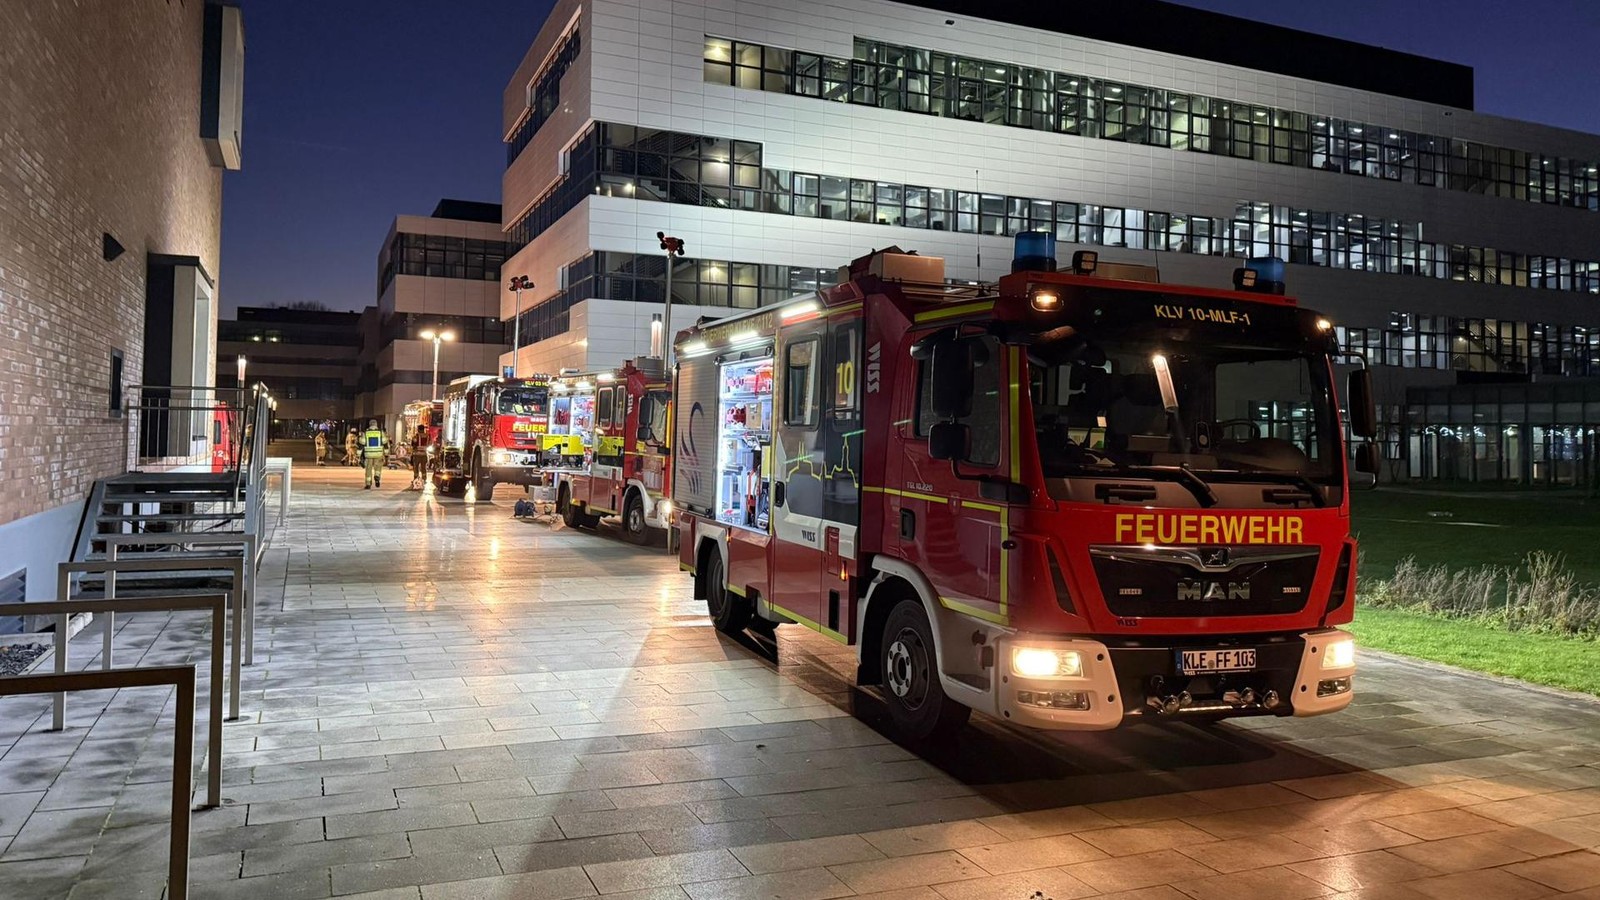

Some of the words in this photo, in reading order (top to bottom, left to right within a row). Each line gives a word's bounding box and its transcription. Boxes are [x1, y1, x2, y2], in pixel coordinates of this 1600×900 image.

[1154, 304, 1183, 319] KLV
[1187, 307, 1251, 326] 10-MLF-1
[836, 361, 855, 394] 10
[1115, 513, 1303, 544] FEUERWEHR
[1177, 582, 1251, 601] MAN
[1183, 652, 1207, 670] KLE
[1216, 651, 1231, 669] FF
[1233, 650, 1256, 667] 103
